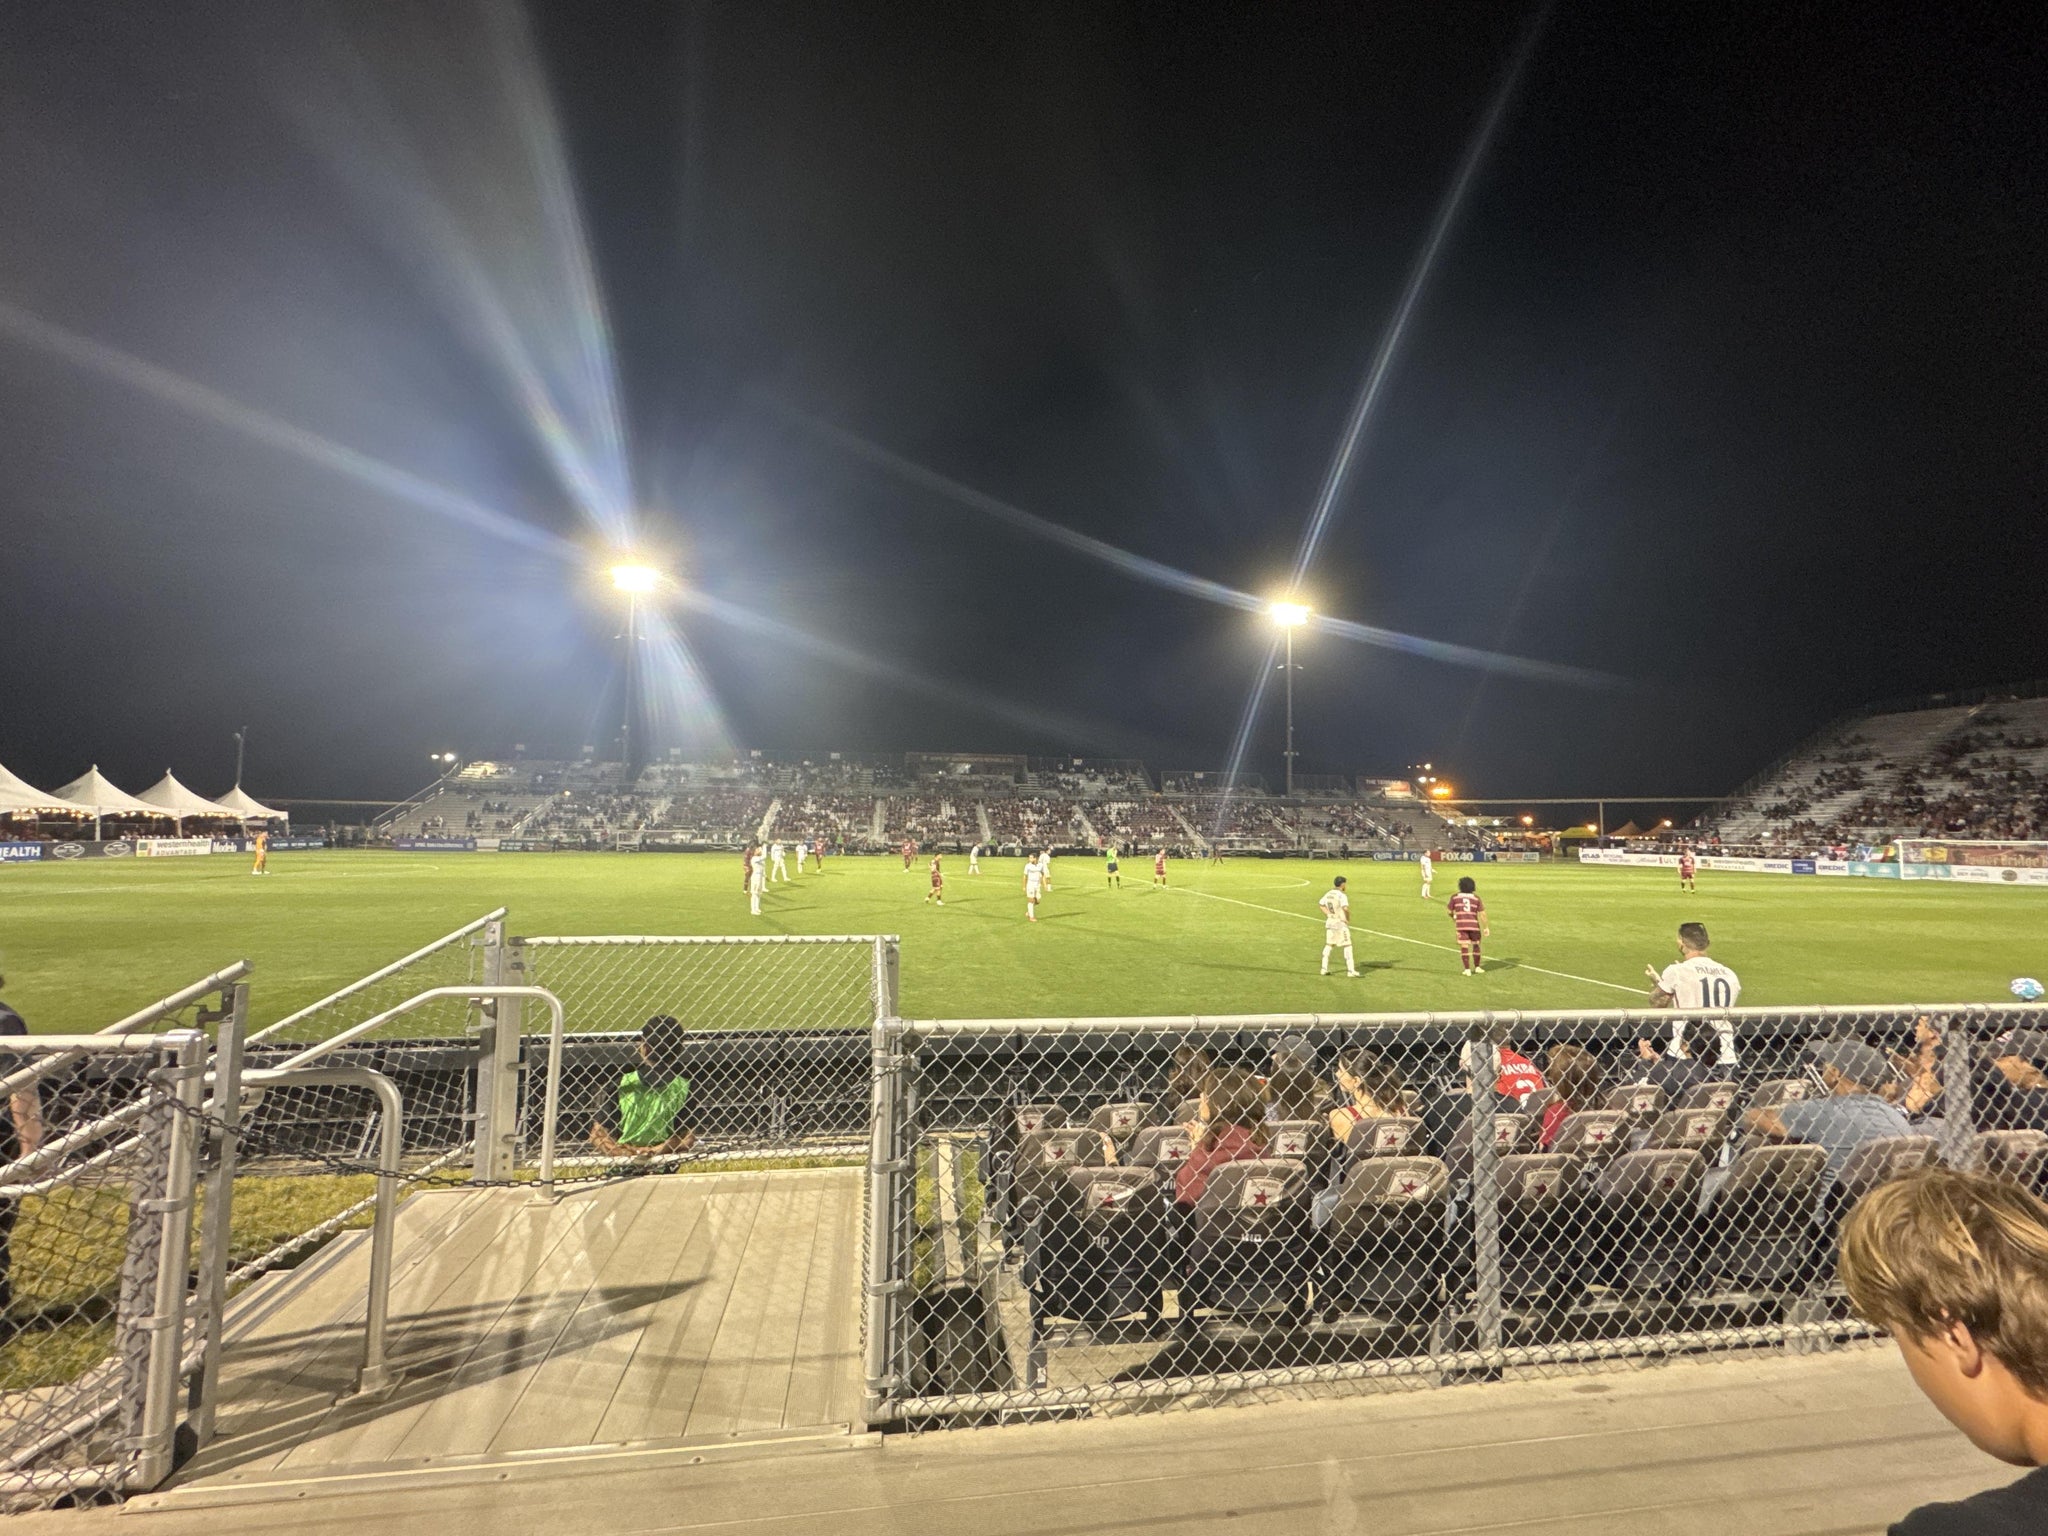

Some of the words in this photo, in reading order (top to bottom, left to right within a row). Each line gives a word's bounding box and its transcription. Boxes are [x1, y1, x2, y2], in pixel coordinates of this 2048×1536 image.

[1440, 852, 1474, 861] FOX40
[1462, 898, 1471, 912] 3
[1699, 977, 1731, 1007] 10
